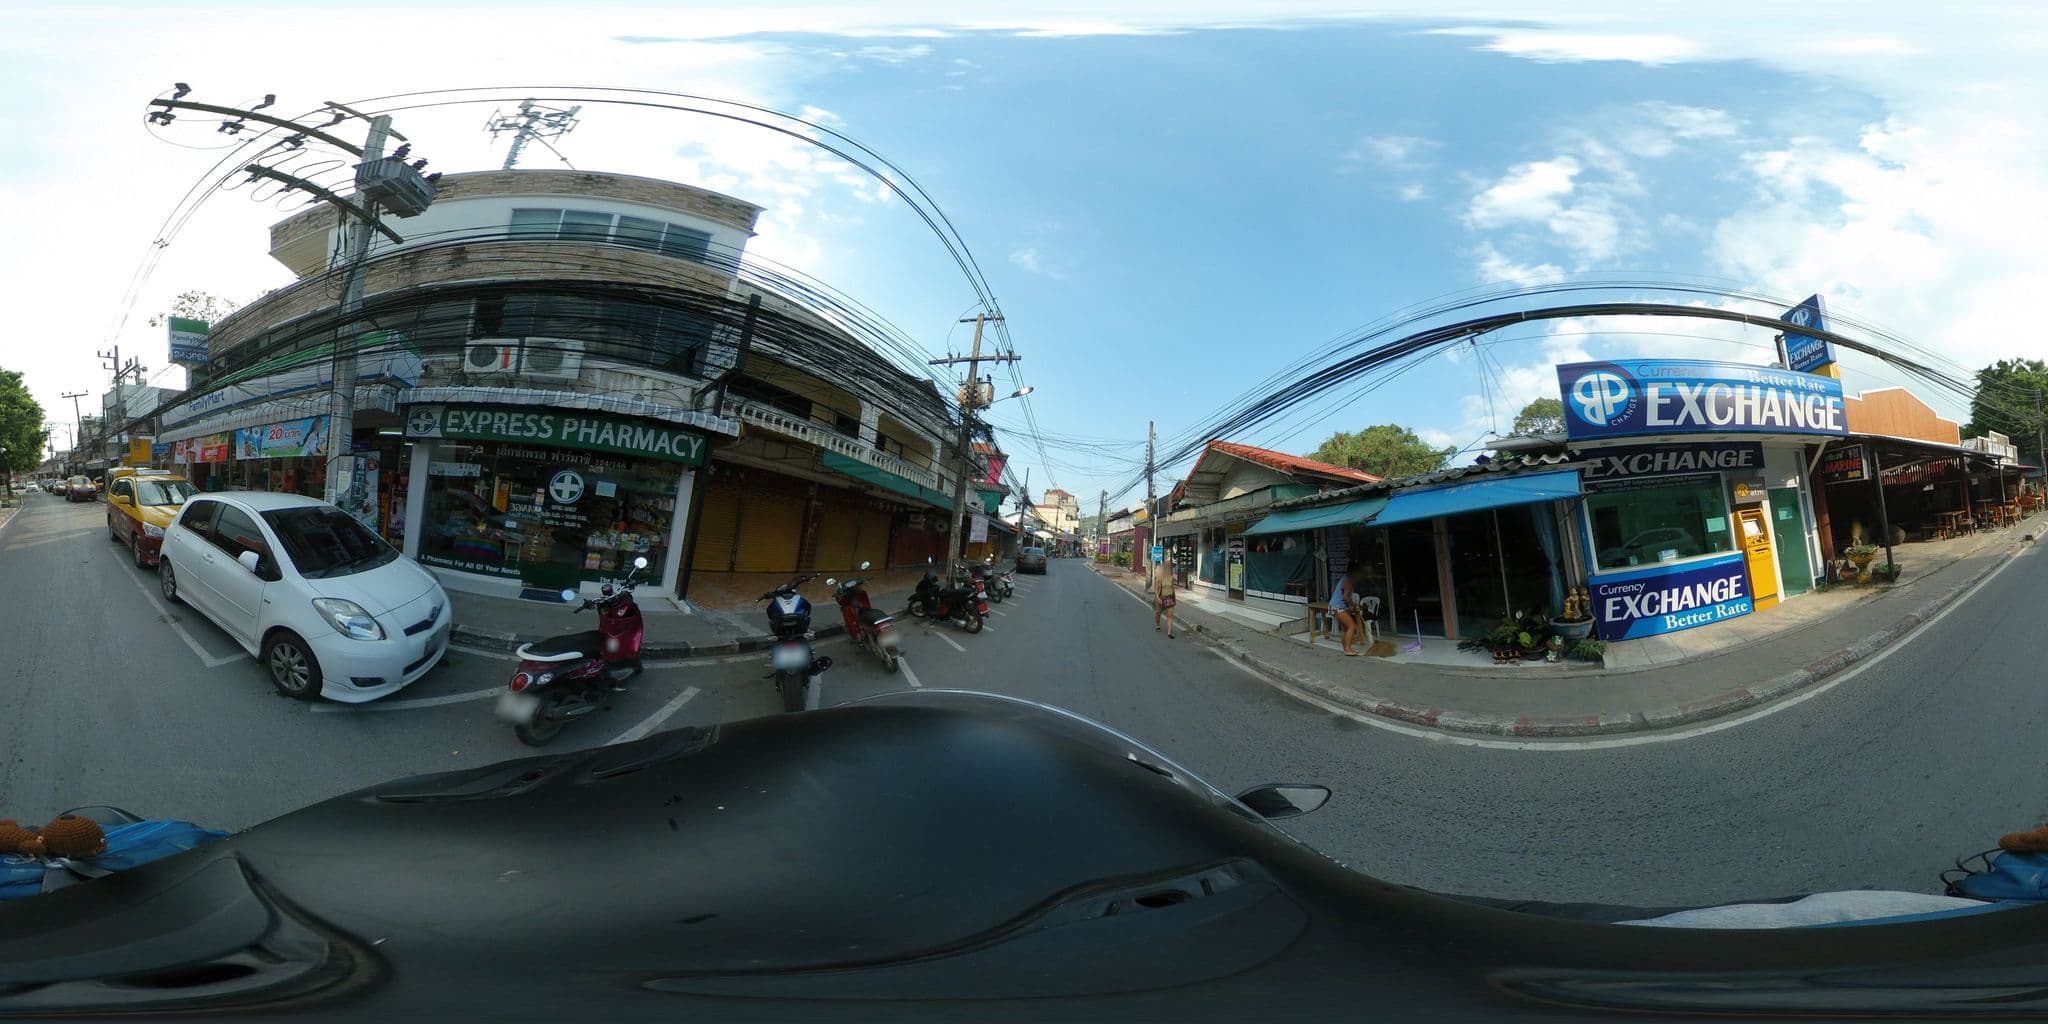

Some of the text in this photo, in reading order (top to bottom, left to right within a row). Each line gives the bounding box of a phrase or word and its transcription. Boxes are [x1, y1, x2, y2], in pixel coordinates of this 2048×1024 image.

[1790, 340, 1825, 364] EXCHANGE
[1810, 352, 1824, 363] Rate
[1746, 369, 1826, 393] Better Rate
[190, 389, 225, 411] FamilyMart
[1611, 398, 1637, 426] CHANGE
[1646, 382, 1843, 431] EXCHANGE
[268, 428, 283, 441] 20
[446, 410, 704, 459] EXPRESS PHARMACY
[1584, 449, 1754, 478] EXCHANGE
[427, 555, 453, 566] Pharmacy
[485, 565, 499, 573] Your
[501, 567, 521, 576] Needs
[1600, 583, 1646, 596] Currency
[1605, 575, 1743, 622] EXCHANGE
[1664, 603, 1748, 630] Better Rate
